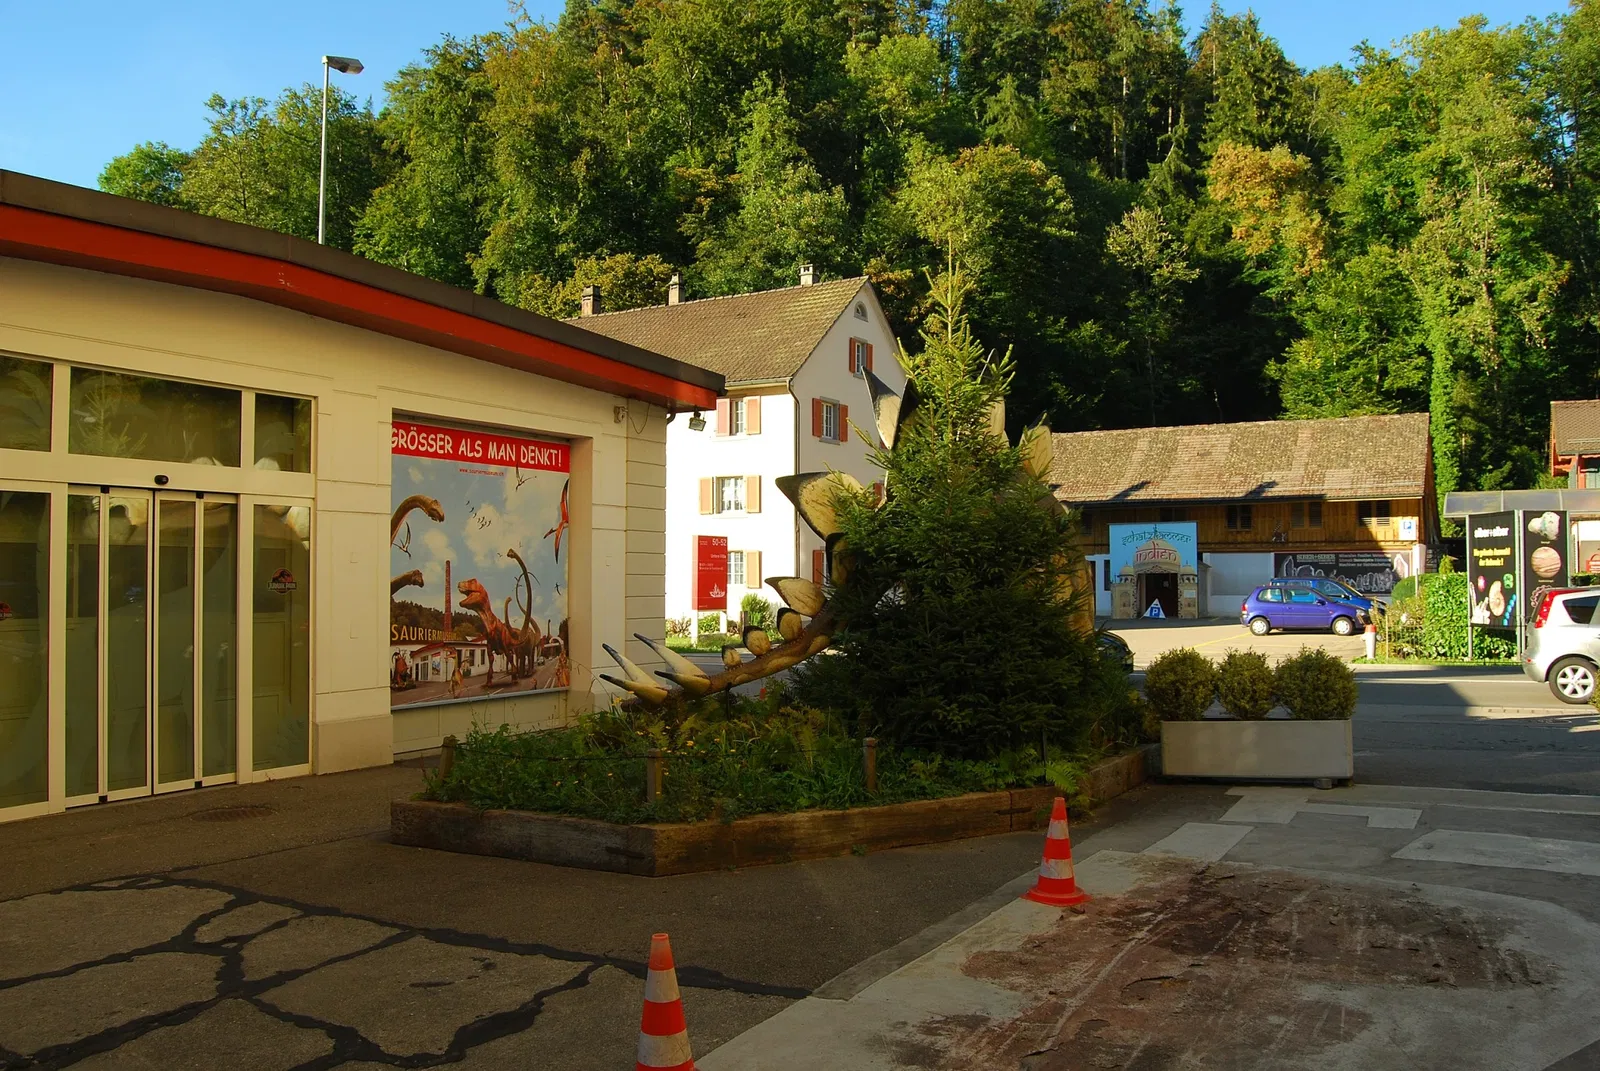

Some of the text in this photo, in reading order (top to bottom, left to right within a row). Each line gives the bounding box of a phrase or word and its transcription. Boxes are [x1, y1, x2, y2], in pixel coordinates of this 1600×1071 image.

[392, 427, 562, 467] GRÖSSER ALS MAN DENKT!
[712, 538, 727, 547] 50-52
[1152, 608, 1159, 616] P
